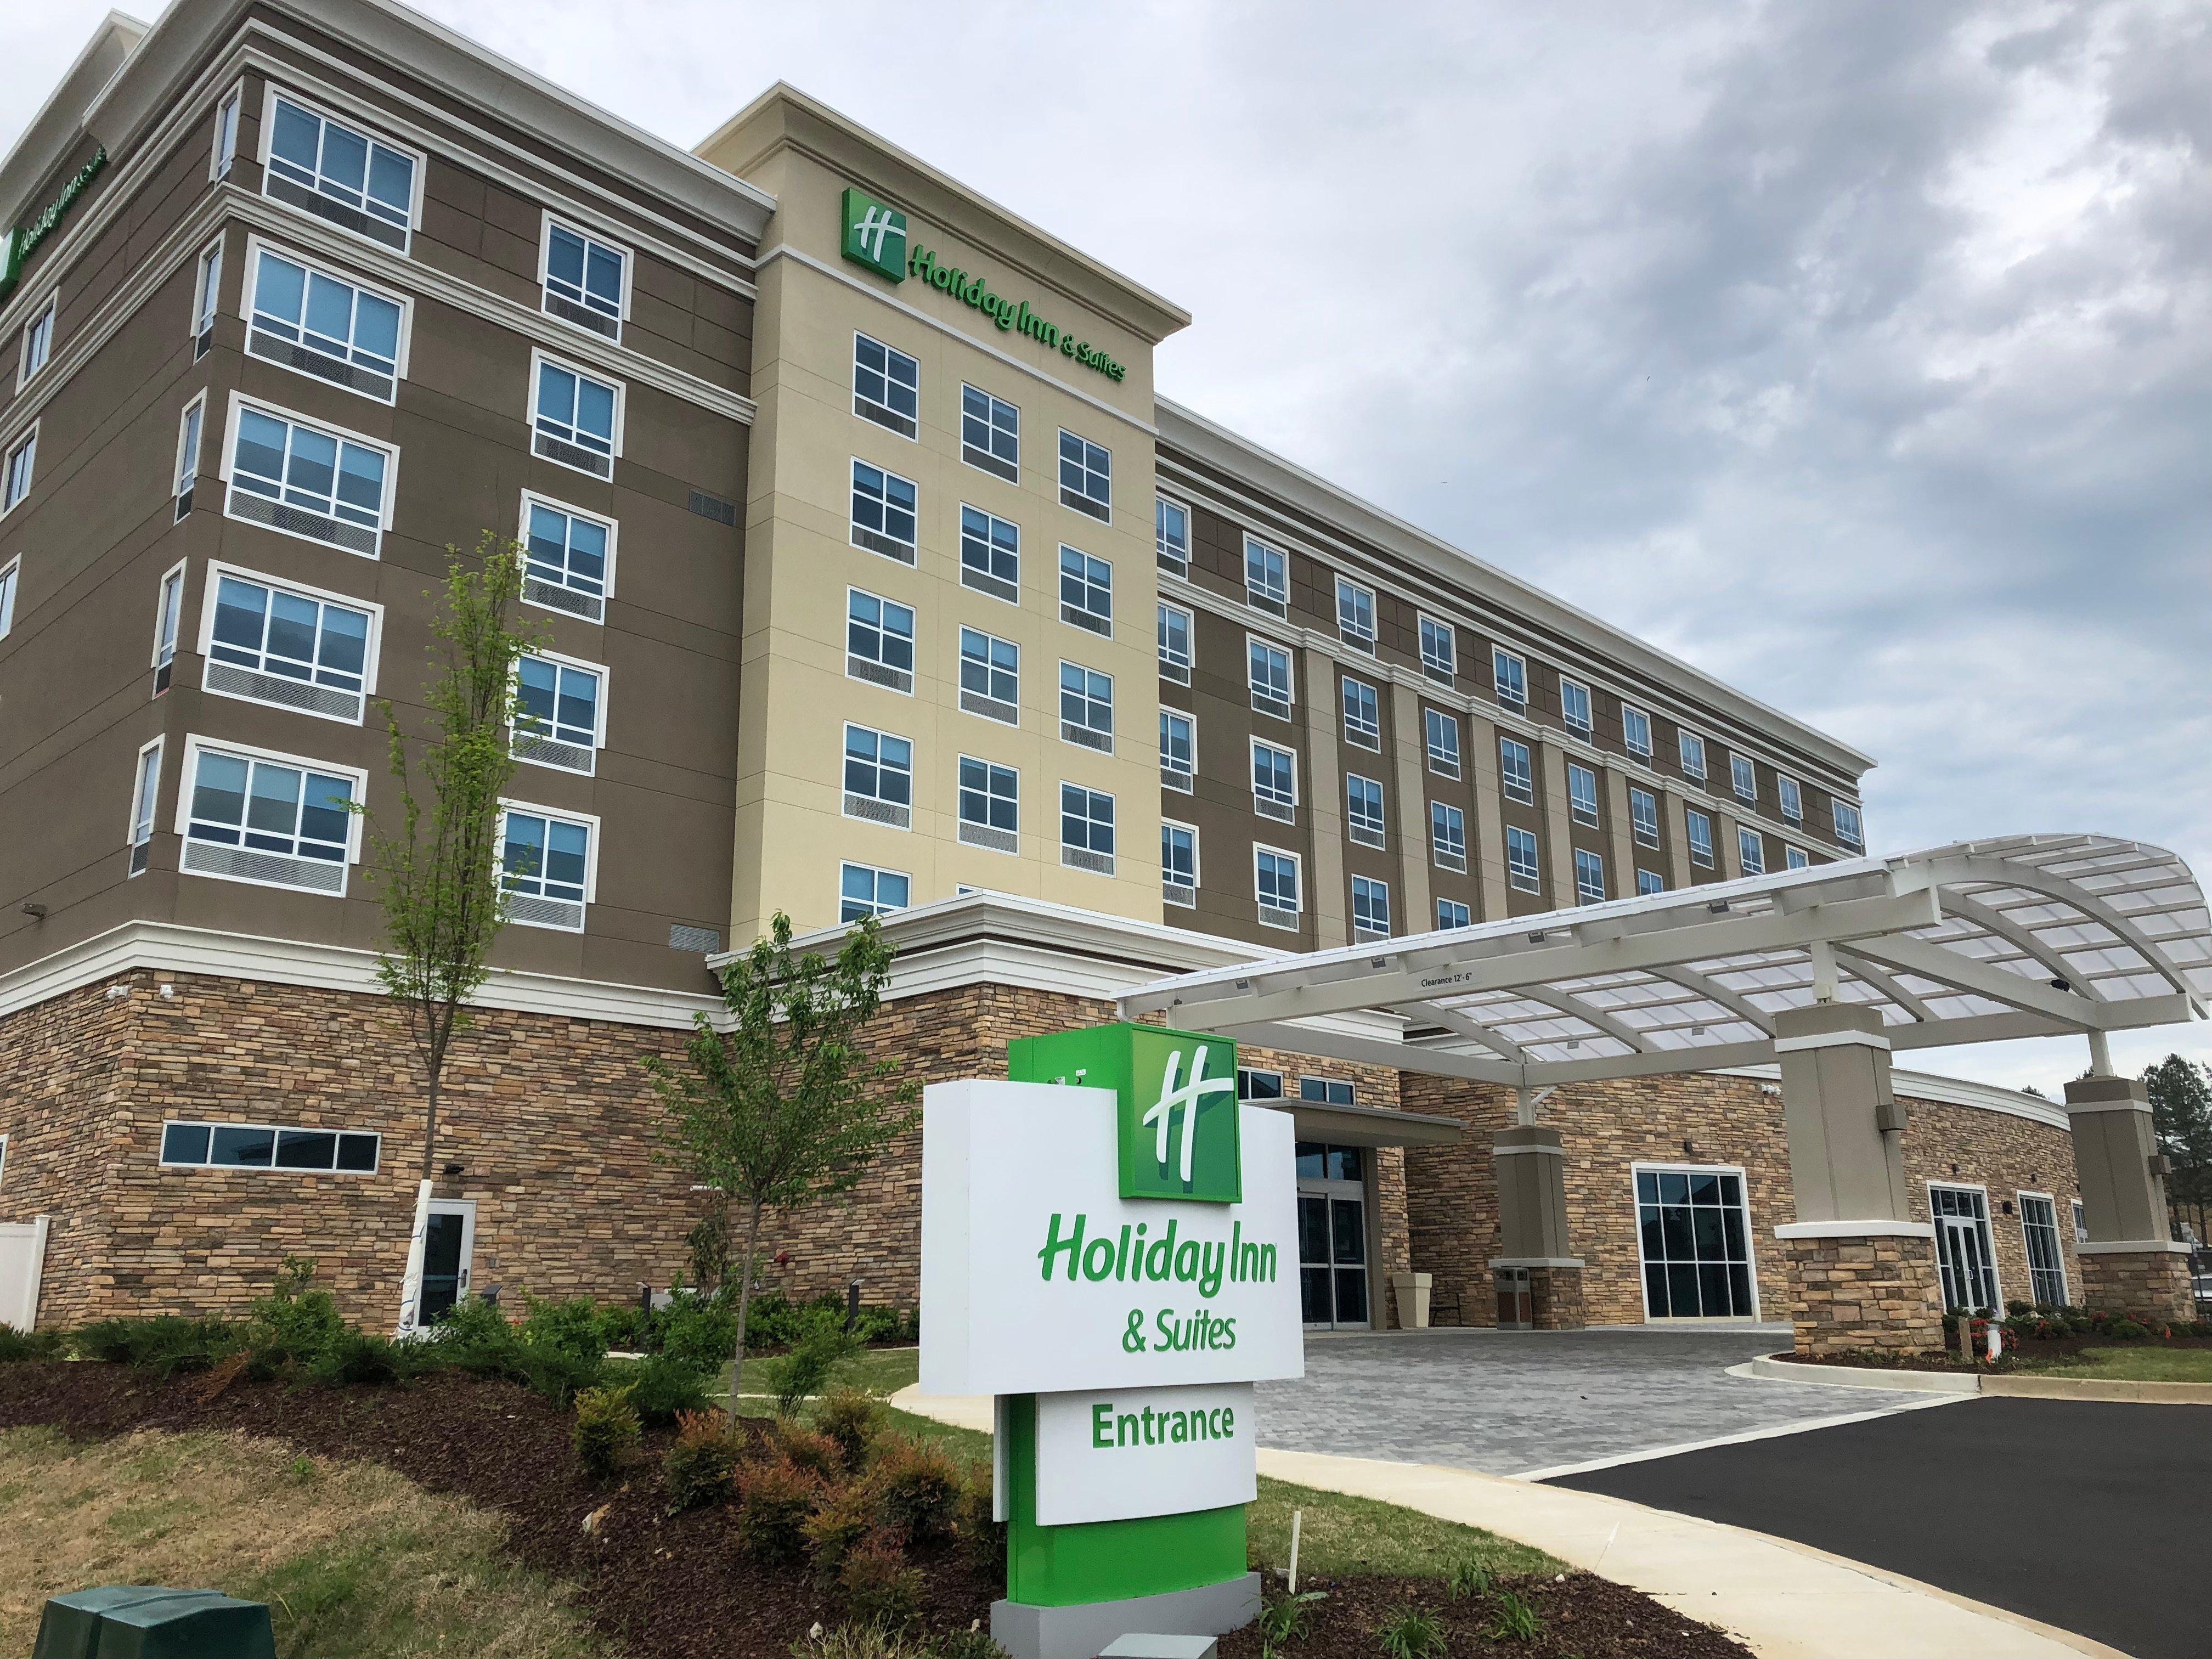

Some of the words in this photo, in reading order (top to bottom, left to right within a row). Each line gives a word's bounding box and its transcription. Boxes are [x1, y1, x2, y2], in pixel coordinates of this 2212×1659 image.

[908, 244, 1017, 330] Holiday
[1017, 300, 1059, 348] Inn
[1060, 334, 1075, 357] &
[1075, 342, 1126, 382] Suites
[1421, 978, 1452, 987] Clearance
[1143, 1045, 1234, 1182] H
[1039, 1214, 1225, 1299] Holiday
[1231, 1221, 1277, 1283] Inn
[1122, 1309, 1146, 1352] &
[1154, 1309, 1236, 1351] Suites
[1092, 1404, 1234, 1449] Entrance
